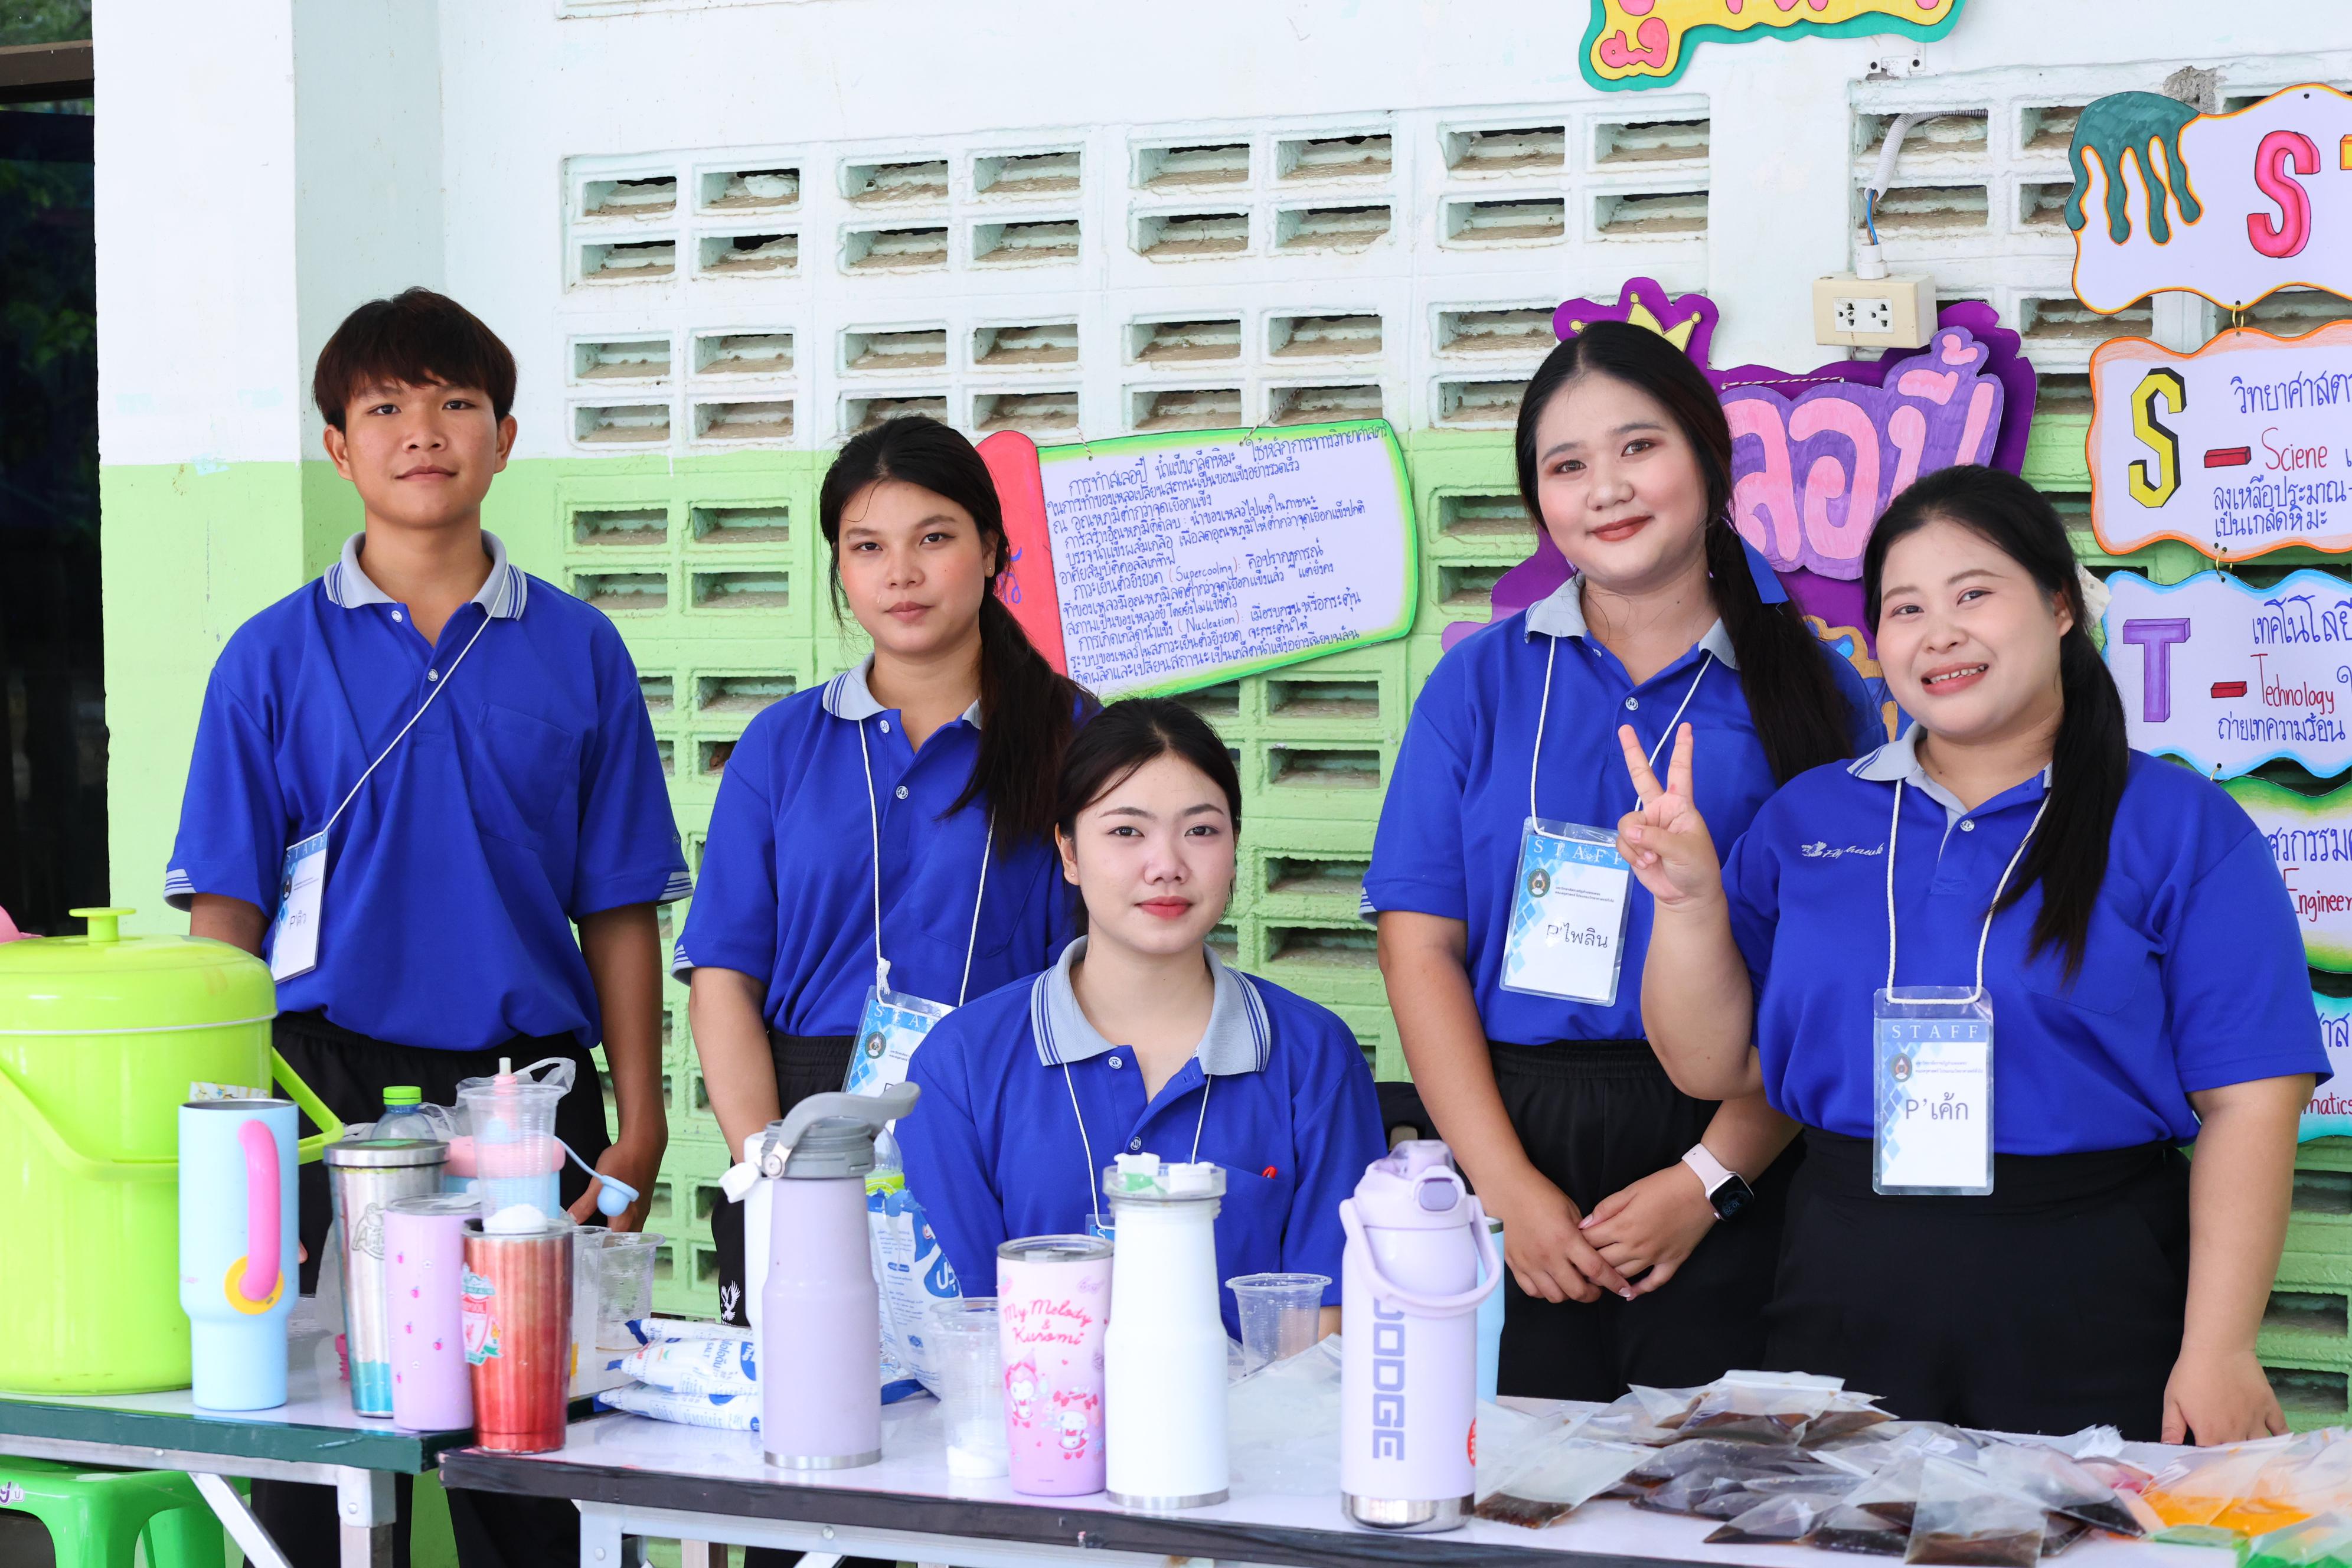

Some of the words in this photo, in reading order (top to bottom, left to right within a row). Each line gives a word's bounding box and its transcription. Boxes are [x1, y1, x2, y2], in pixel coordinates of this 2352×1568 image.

[2247, 130, 2321, 259] S
[2230, 370, 2352, 414] วิทยาศาสต
[2129, 367, 2187, 509] S
[2262, 427, 2328, 472] Sciene
[2123, 618, 2191, 723] T
[2250, 653, 2335, 715] Technology
[1892, 1024, 1979, 1039] STAFF
[1004, 1302, 1027, 1325] My
[1030, 1299, 1093, 1327] Melody
[1012, 1326, 1085, 1345] Kuromi
